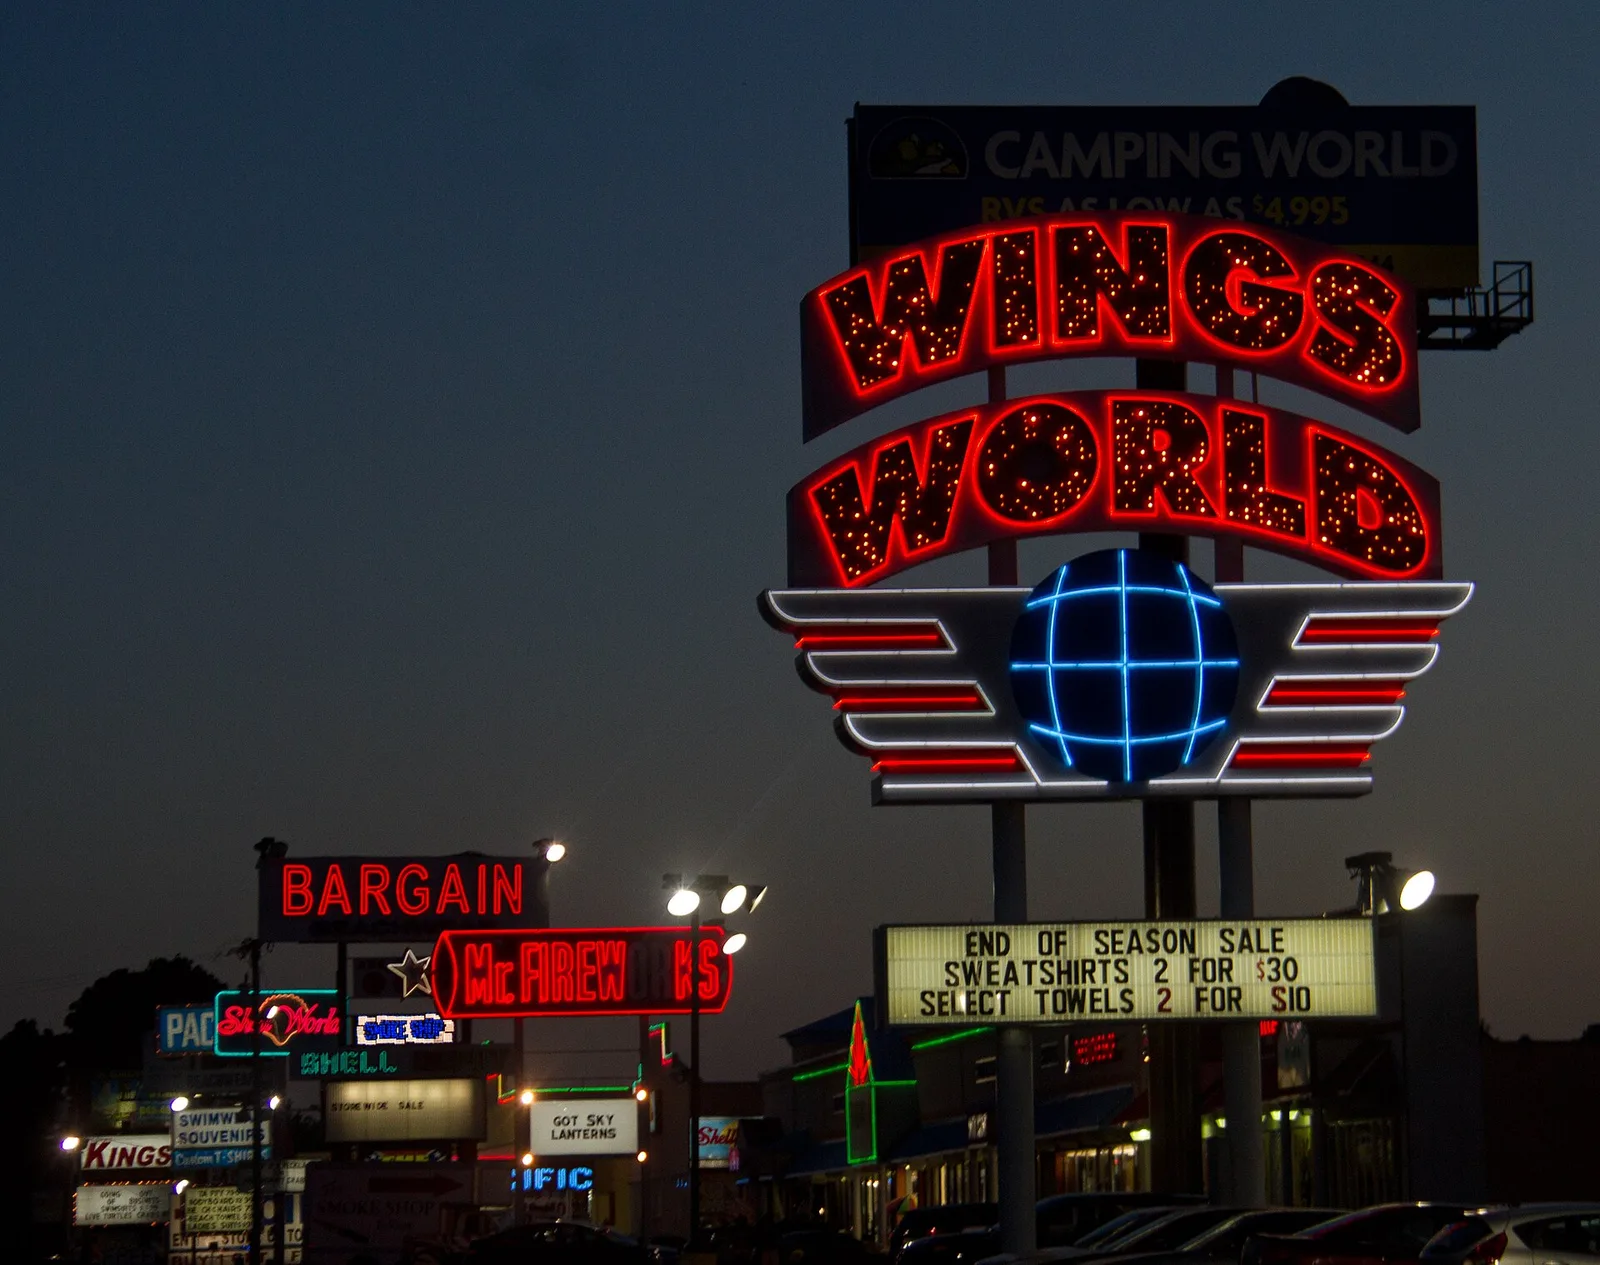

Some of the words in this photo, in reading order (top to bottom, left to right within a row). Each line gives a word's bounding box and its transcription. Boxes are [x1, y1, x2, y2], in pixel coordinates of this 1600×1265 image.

[983, 129, 1239, 179] CAMPING
[1251, 129, 1458, 178] WORLD
[980, 196, 1044, 224] RVS
[1203, 196, 1243, 222] AS
[1253, 193, 1350, 226] $4,995
[817, 220, 1406, 398] WINGS
[808, 393, 1428, 587] WORLD
[281, 863, 524, 917] BARGAIN
[966, 931, 1010, 957] END
[1038, 930, 1067, 956] OF
[1094, 928, 1196, 956] SEASON
[1219, 928, 1285, 954] SALE
[944, 957, 1129, 987] SWEATSHIRTS
[1154, 958, 1169, 984] 2
[1188, 957, 1234, 984] FOR
[1256, 956, 1299, 983] $30
[920, 989, 1011, 1017] SELECT
[1034, 987, 1135, 1015] TOWELS
[1157, 986, 1173, 1013] 2
[1195, 986, 1243, 1013] FOR
[1271, 985, 1311, 1014] $10
[364, 1020, 408, 1041] SMOKE
[409, 1018, 445, 1040] SHOP
[300, 1050, 397, 1075] SHELL
[397, 1100, 425, 1111] SALE
[552, 1115, 579, 1127] GOT
[586, 1113, 615, 1127] SKY
[551, 1128, 618, 1141] LANTERNS
[511, 1167, 594, 1191] IFIC
